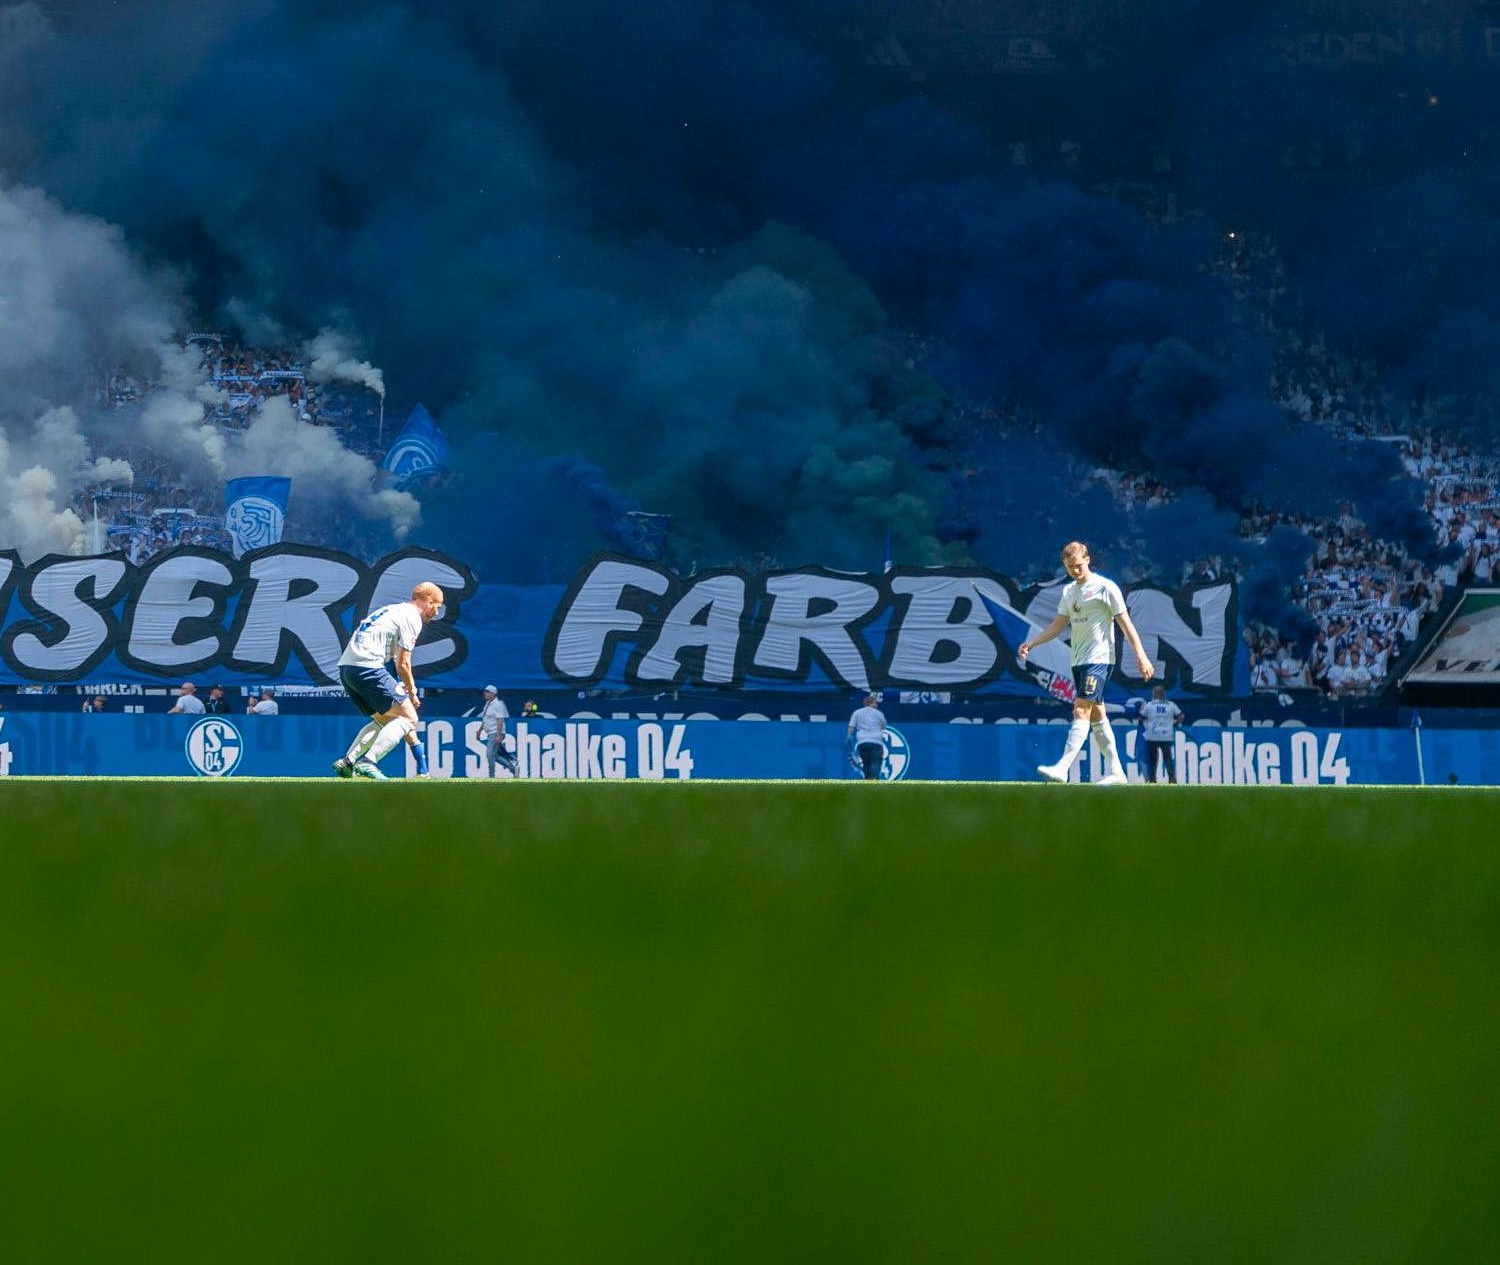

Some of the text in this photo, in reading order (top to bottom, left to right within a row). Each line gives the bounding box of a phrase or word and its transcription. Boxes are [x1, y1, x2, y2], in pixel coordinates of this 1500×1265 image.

[543, 551, 1238, 690] FARBN
[638, 723, 694, 780] 04
[1291, 732, 1350, 785] 04
